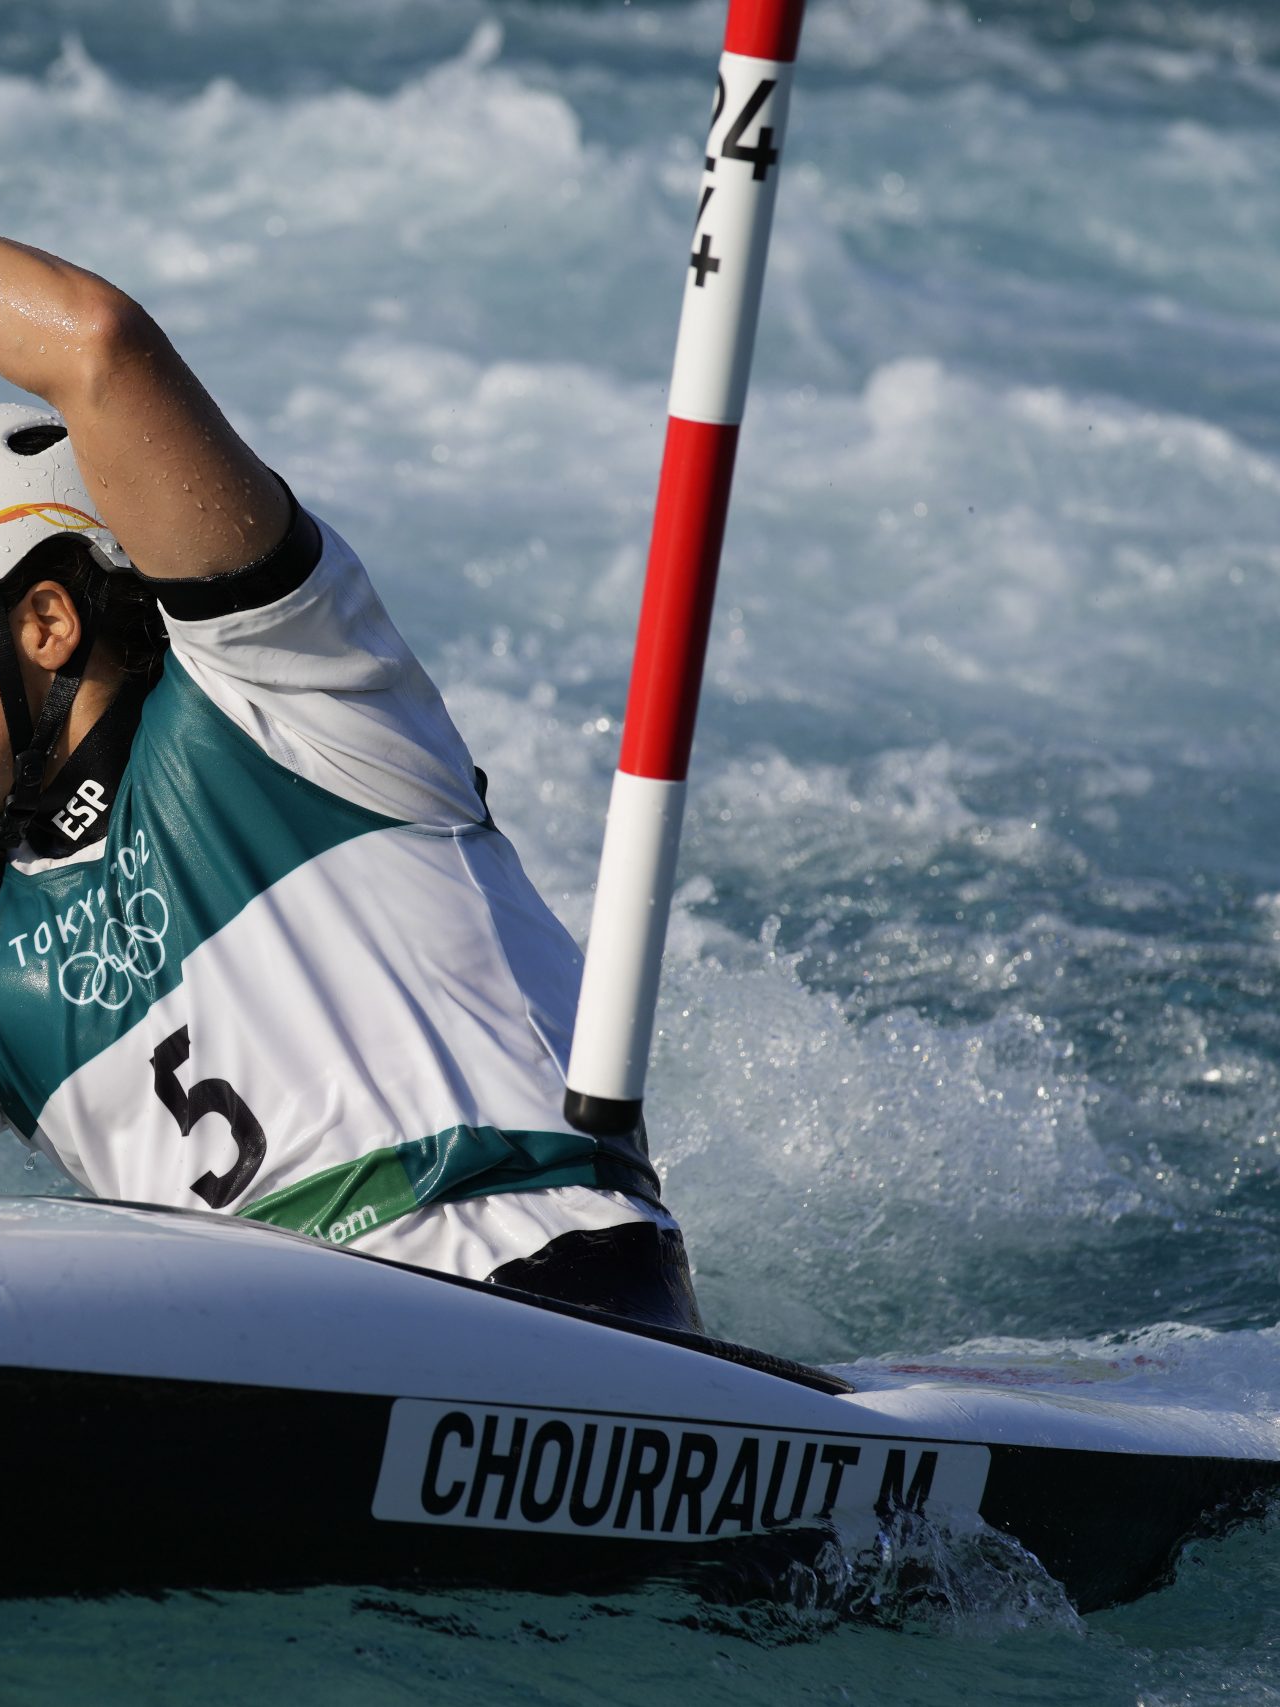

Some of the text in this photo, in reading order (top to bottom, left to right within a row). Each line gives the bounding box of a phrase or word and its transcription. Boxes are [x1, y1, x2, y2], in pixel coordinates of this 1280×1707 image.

[51, 778, 109, 841] ESP
[150, 1024, 268, 1210] 5
[420, 1410, 939, 1536] CHOURRAUT M
